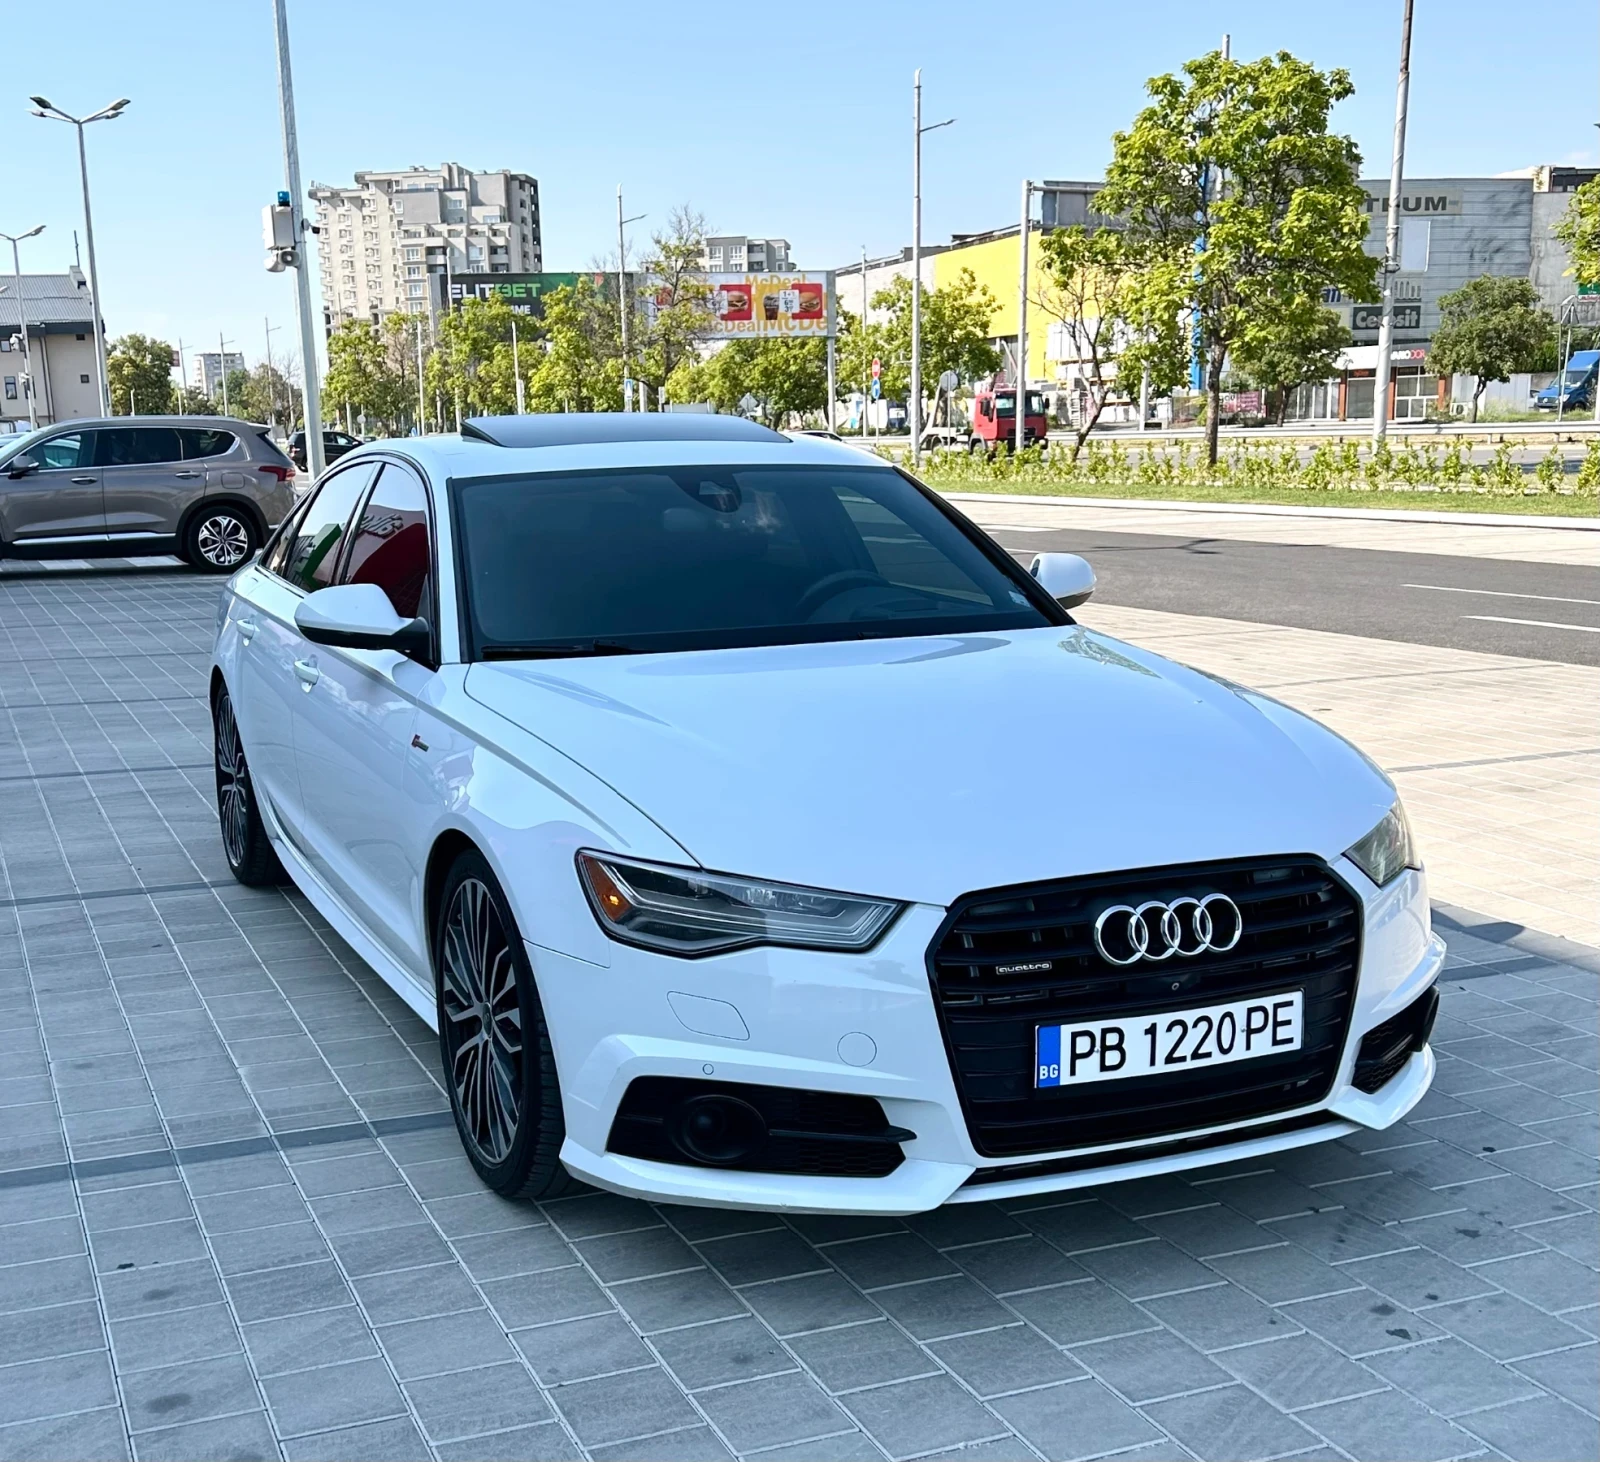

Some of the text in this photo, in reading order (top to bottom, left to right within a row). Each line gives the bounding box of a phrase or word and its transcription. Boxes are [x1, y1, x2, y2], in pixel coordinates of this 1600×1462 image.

[998, 963, 1050, 973] quattro
[1069, 1000, 1294, 1077] PB 1220 PE
[1039, 1065, 1059, 1080] BG
